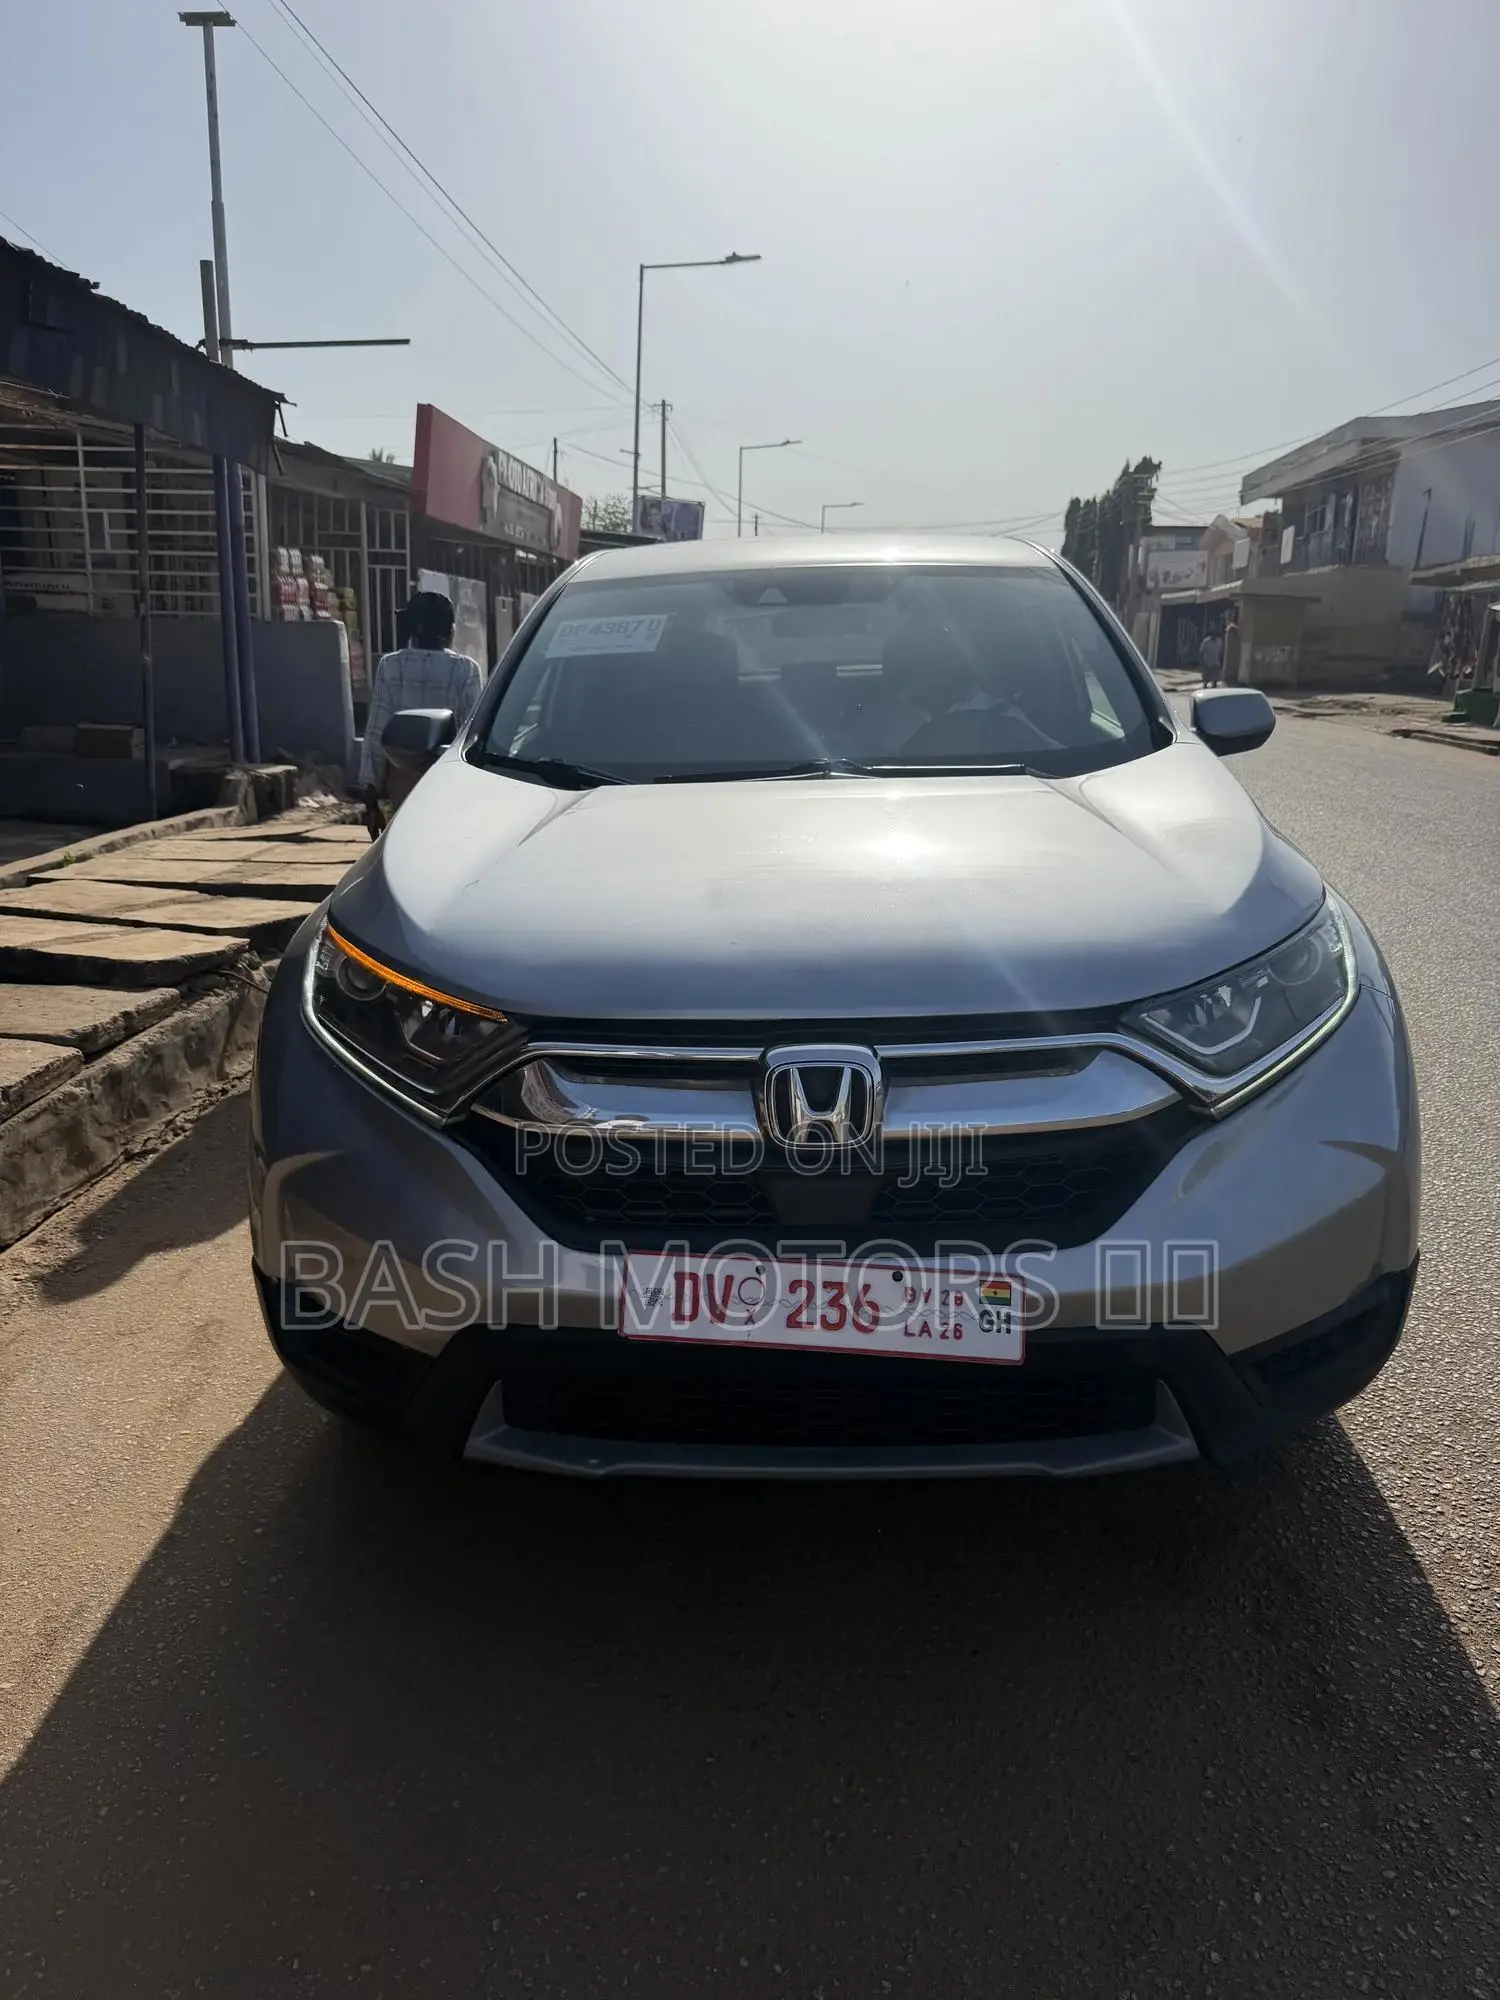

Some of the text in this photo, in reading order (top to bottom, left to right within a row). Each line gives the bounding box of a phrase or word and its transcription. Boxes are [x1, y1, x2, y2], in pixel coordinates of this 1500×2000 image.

[672, 1271, 880, 1334] DV 236
[904, 1320, 963, 1340] LA 26
[979, 1309, 1012, 1334] GH
